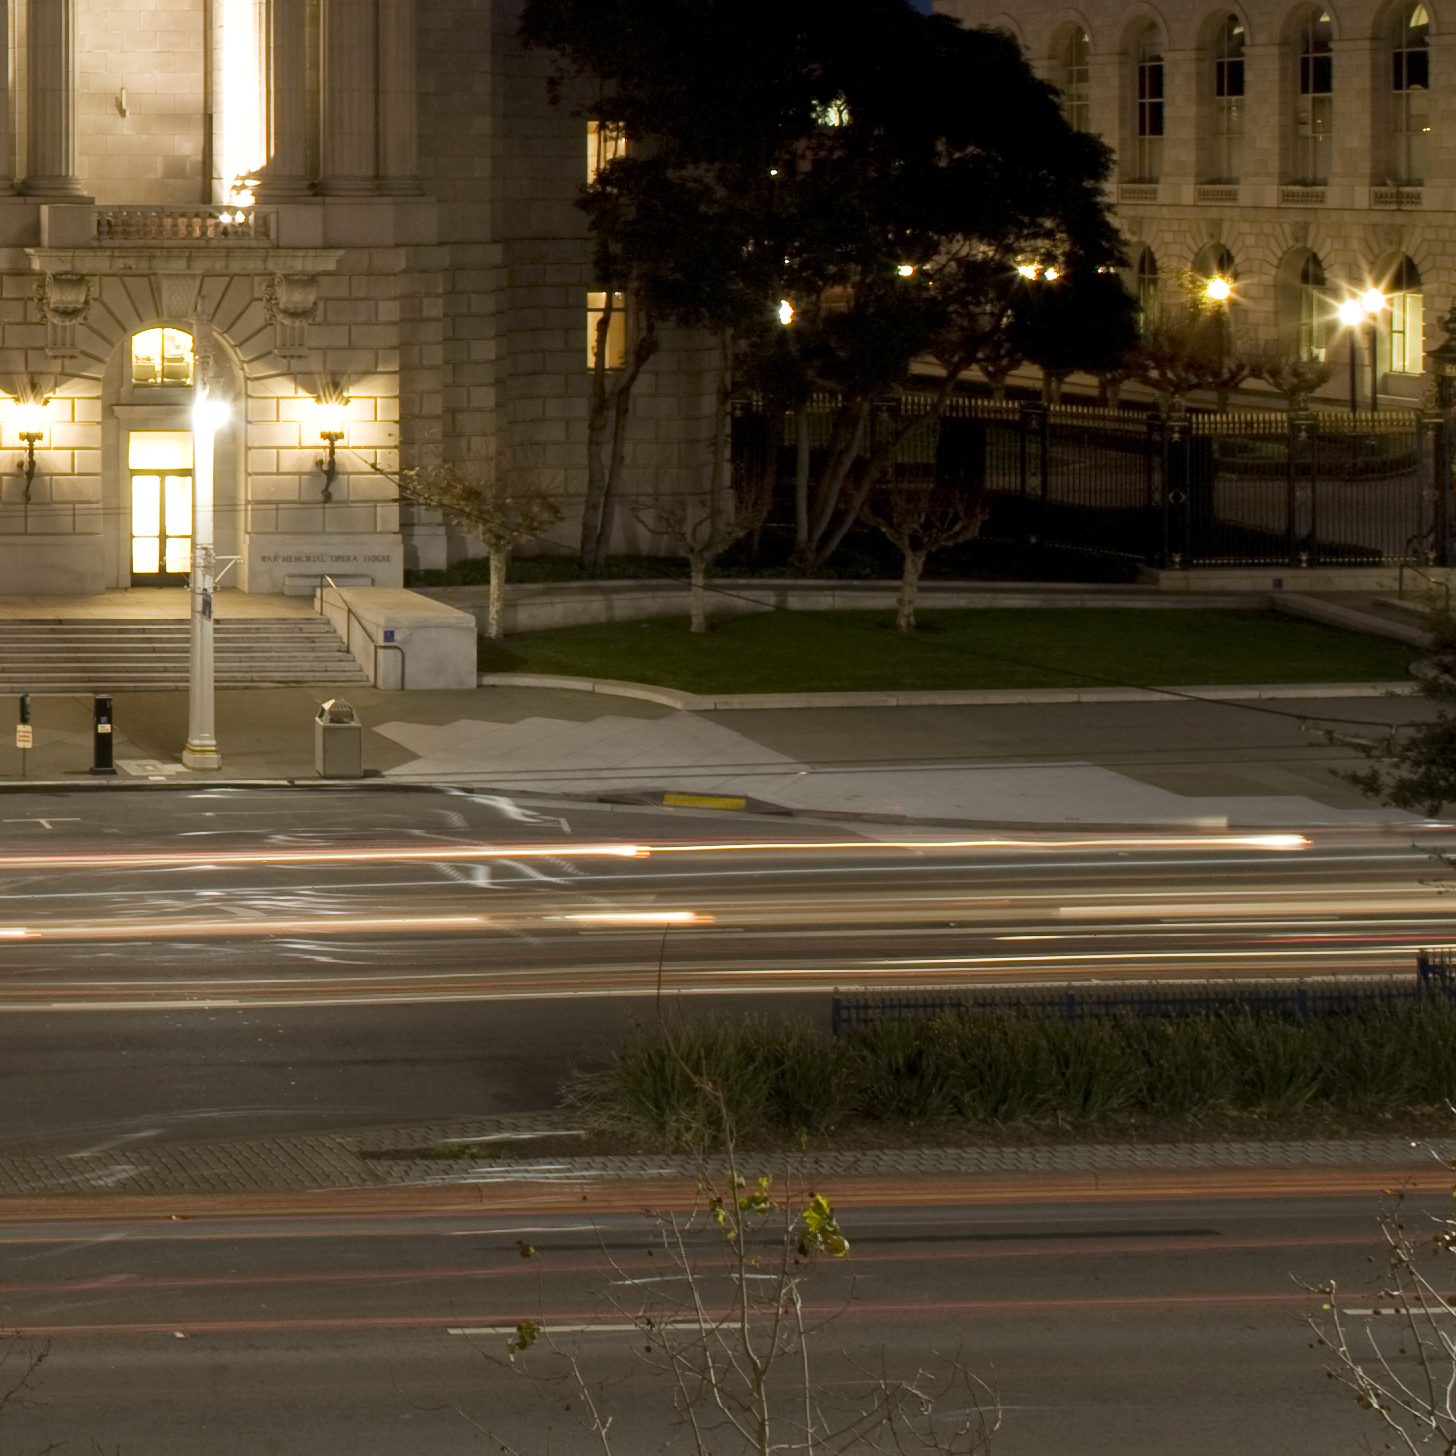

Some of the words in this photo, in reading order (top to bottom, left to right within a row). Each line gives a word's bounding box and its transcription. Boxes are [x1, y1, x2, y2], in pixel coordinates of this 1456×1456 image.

[260, 555, 278, 563] WAR
[281, 555, 326, 563] MEMORIAL
[330, 555, 358, 563] OPERA
[363, 555, 391, 563] HOUSE
